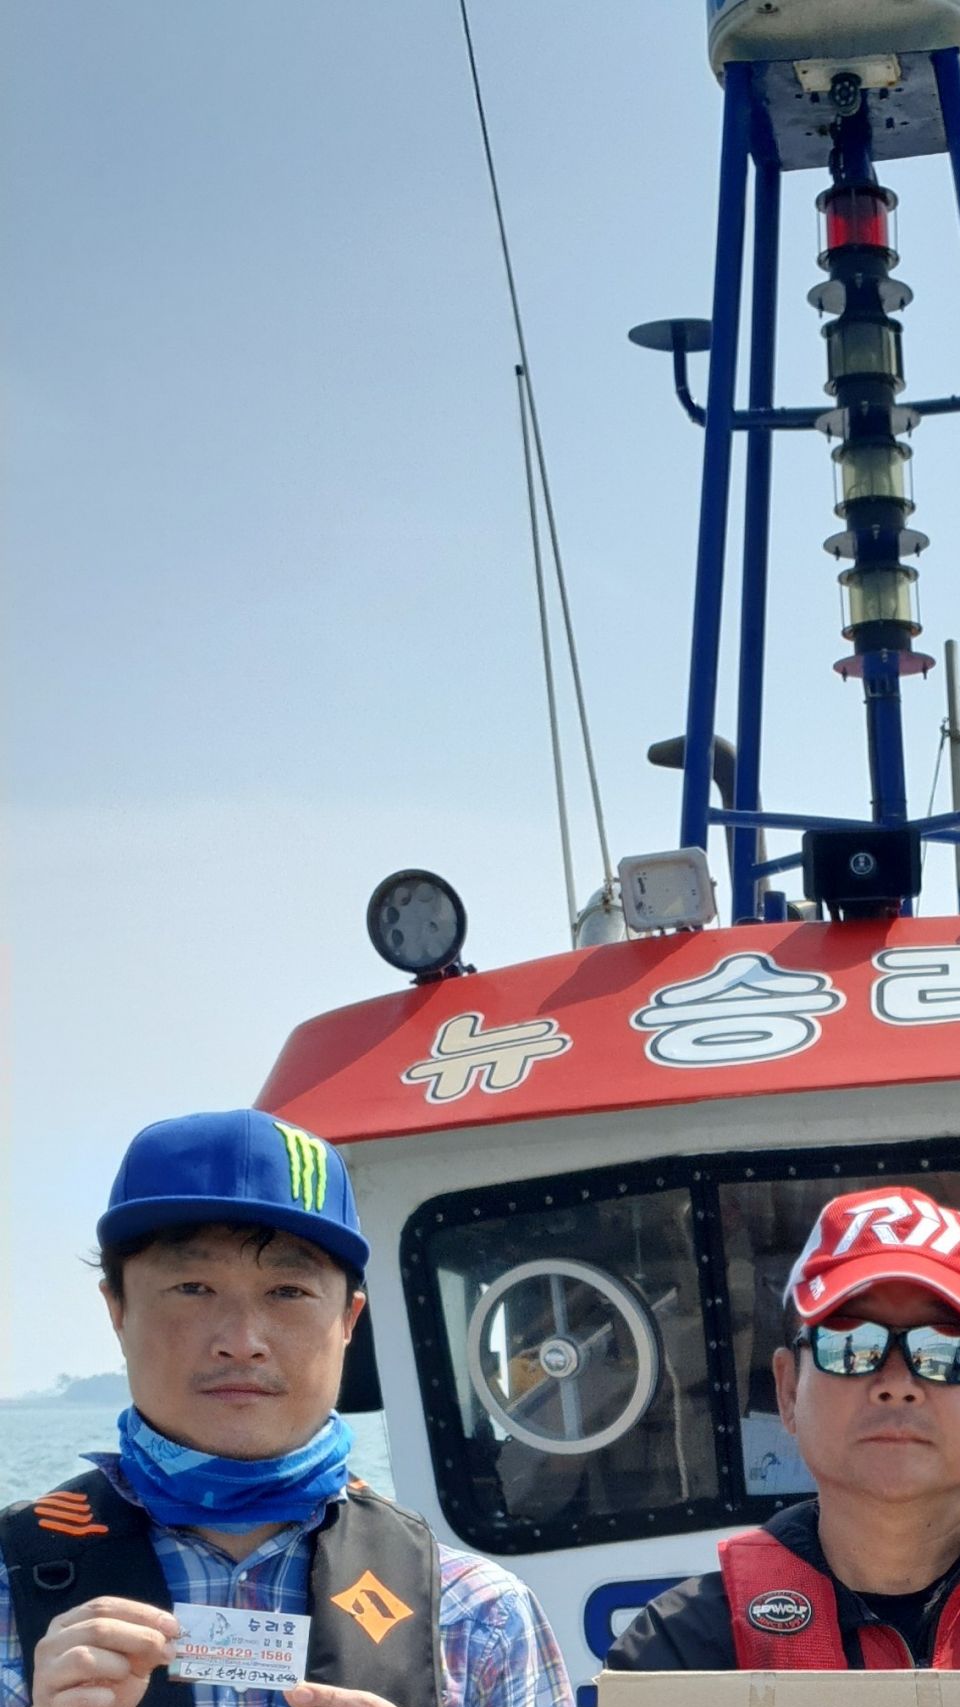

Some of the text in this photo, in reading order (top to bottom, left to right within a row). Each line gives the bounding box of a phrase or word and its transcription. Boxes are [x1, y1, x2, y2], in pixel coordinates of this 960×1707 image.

[401, 1011, 574, 1104] 뉴
[753, 1602, 808, 1619] SEAWOLF
[248, 1617, 296, 1636] 승리호
[185, 1643, 292, 1662] 010-3429-1586
